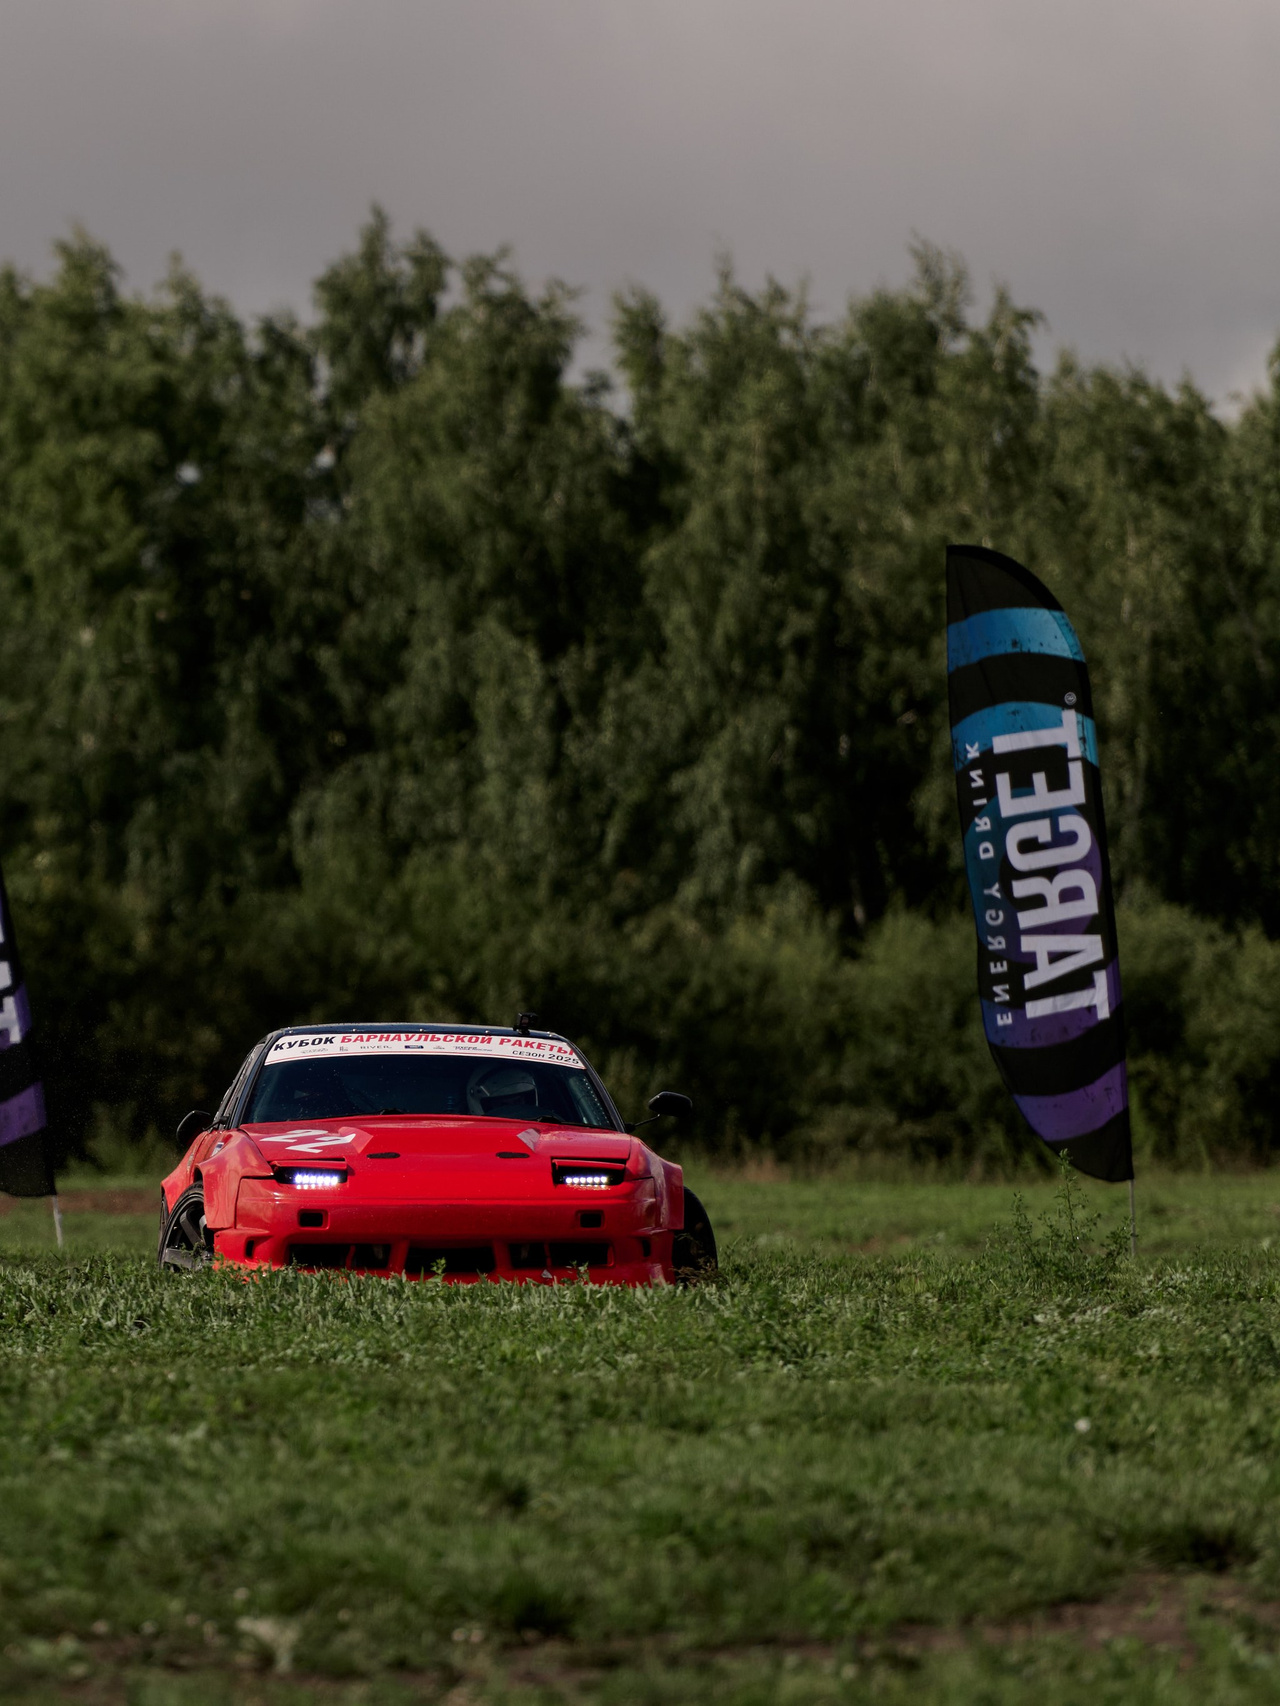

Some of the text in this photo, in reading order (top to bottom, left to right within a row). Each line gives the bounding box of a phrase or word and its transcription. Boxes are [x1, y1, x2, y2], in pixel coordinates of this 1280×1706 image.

[273, 1034, 576, 1056] КУБОК БАРНАУЛЬСКОЙ РАКЕТЫ
[512, 1050, 580, 1065] СЕЗОН 2025
[259, 1129, 357, 1154] 22
